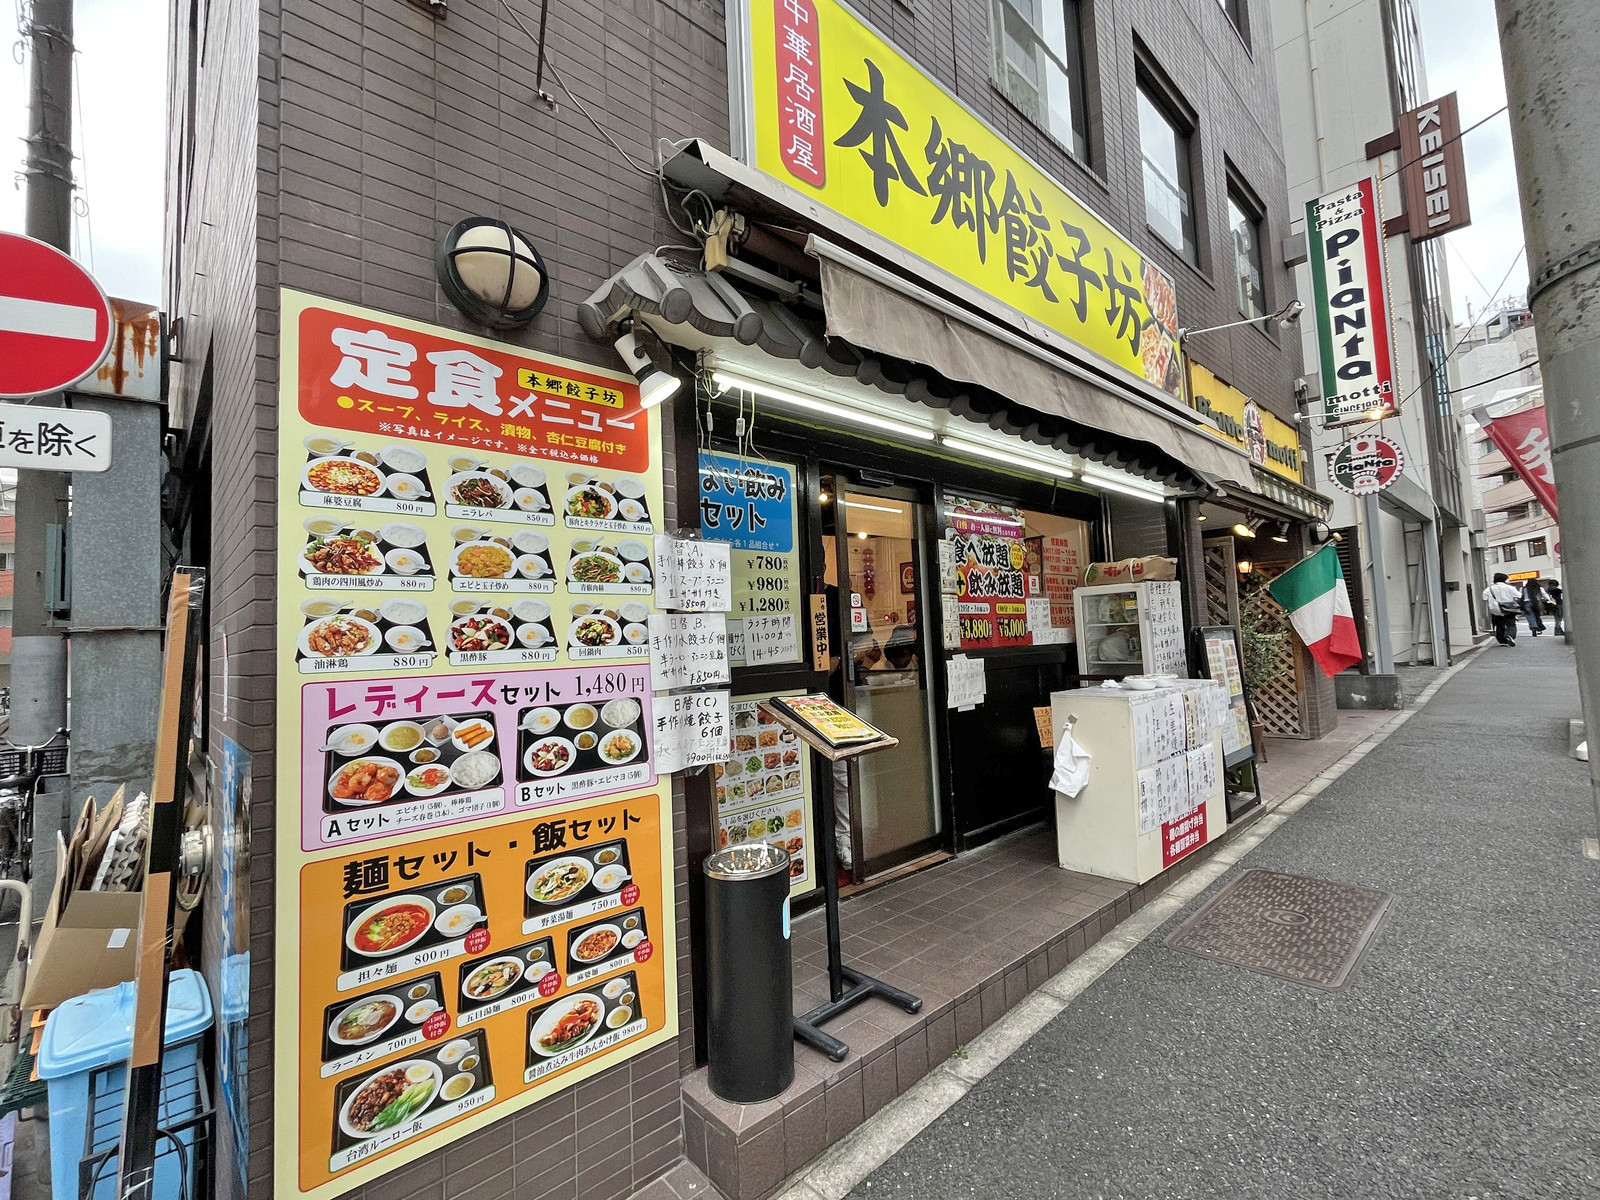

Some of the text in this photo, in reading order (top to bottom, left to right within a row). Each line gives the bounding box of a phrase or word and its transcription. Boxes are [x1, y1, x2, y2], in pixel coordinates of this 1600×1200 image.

[783, 0, 818, 176] 中華居酒屋
[1417, 104, 1451, 228] KEISEI
[833, 58, 1141, 357] 本郷餃子坊
[1314, 191, 1363, 215] Pasta
[1335, 207, 1344, 215] &
[1316, 208, 1364, 230] Pizza
[526, 371, 618, 406] 本郷餃子坊
[1327, 381, 1391, 405] motti
[0, 422, 96, 457] を除く
[395, 501, 424, 513] 800円
[525, 513, 549, 523] 850円
[700, 498, 767, 533] セット
[746, 556, 783, 570] ¥780
[399, 579, 426, 589] 880円
[528, 581, 550, 591] 880円
[748, 576, 783, 591] ¥980
[968, 570, 1024, 597] 飲み放題
[739, 597, 784, 612] ¥1,280
[815, 612, 827, 655] 営業中
[313, 655, 428, 670] 油淋鶏 880円
[521, 650, 550, 662] 880円
[326, 672, 646, 721] レディースセット 1,480円
[701, 725, 724, 738] 6個
[521, 783, 566, 802] Bセット
[327, 813, 390, 838] Aセット
[414, 948, 450, 966] 800円
[332, 1035, 417, 1070] ラーメン 700円
[346, 1094, 486, 1163] 台湾ルーロー飯 950円
